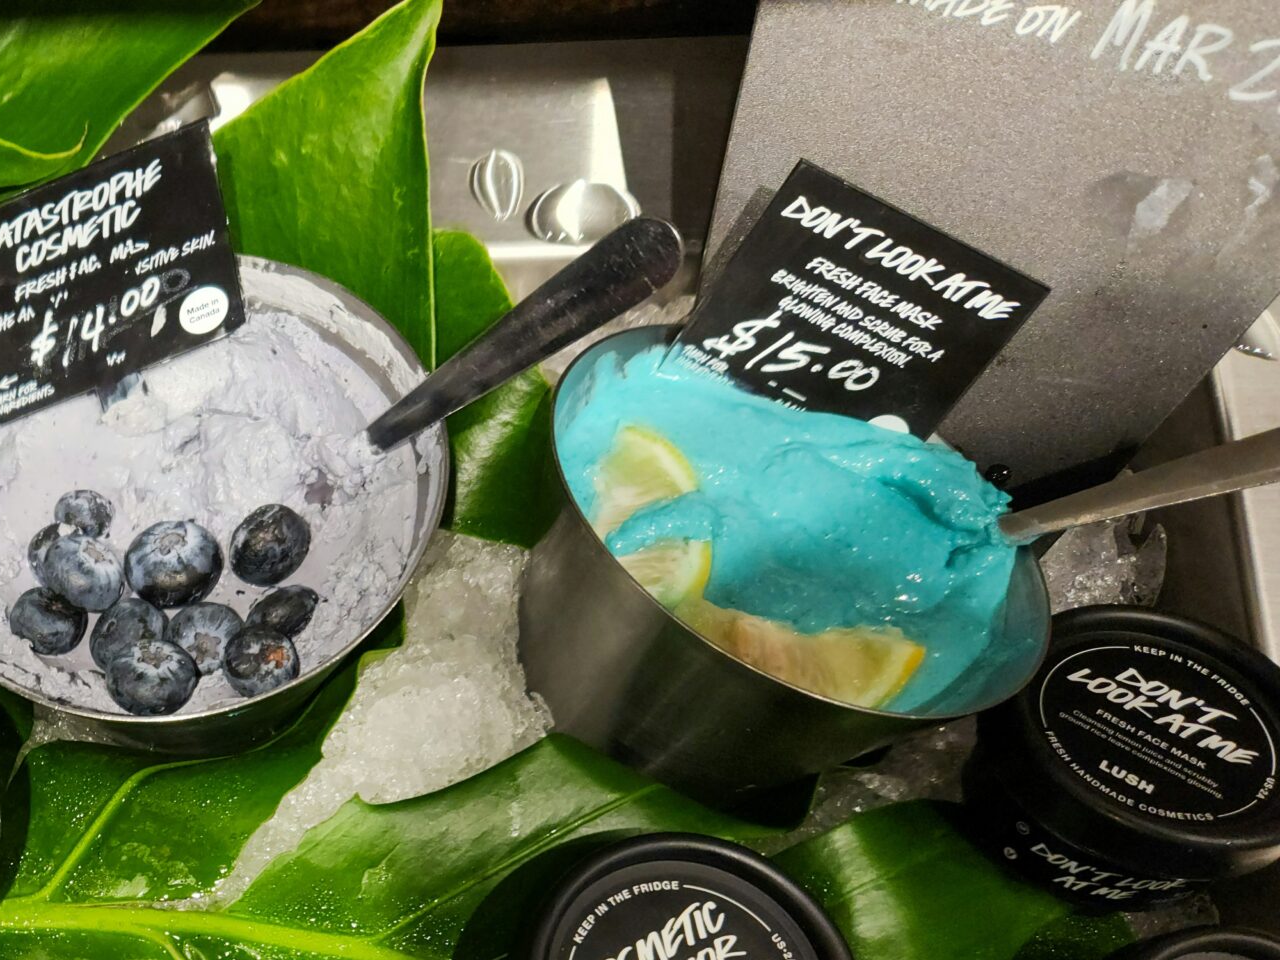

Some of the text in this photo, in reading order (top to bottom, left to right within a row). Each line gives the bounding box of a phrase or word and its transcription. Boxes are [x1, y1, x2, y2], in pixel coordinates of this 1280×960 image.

[1016, 0, 1234, 81] ON MAR
[15, 200, 142, 272] COSMETIC
[181, 230, 215, 256] SKIN.
[781, 196, 1021, 321] DON'T LOOK AT ME
[15, 267, 67, 302] FRESH
[186, 298, 219, 316] Made in
[189, 308, 220, 324] Canada
[770, 269, 945, 363] BRIGHTEN AND SCRUB FOR A
[805, 257, 943, 332] FRESH FACE MASK
[719, 309, 880, 391] $15.00
[778, 295, 913, 369] GLOWING COMPLEXION.
[1114, 667, 1238, 724] DON'T
[1134, 644, 1250, 706] KEEP IN THE FRIDGE
[1067, 668, 1259, 766] LOOK AT ME
[1096, 709, 1207, 769] FRESH FACE MASK
[1045, 730, 1214, 821] FRESH HANDMADE COSMETICS
[1098, 760, 1155, 794] LUSH
[573, 880, 679, 944] KEEP IN THE FRIDGE
